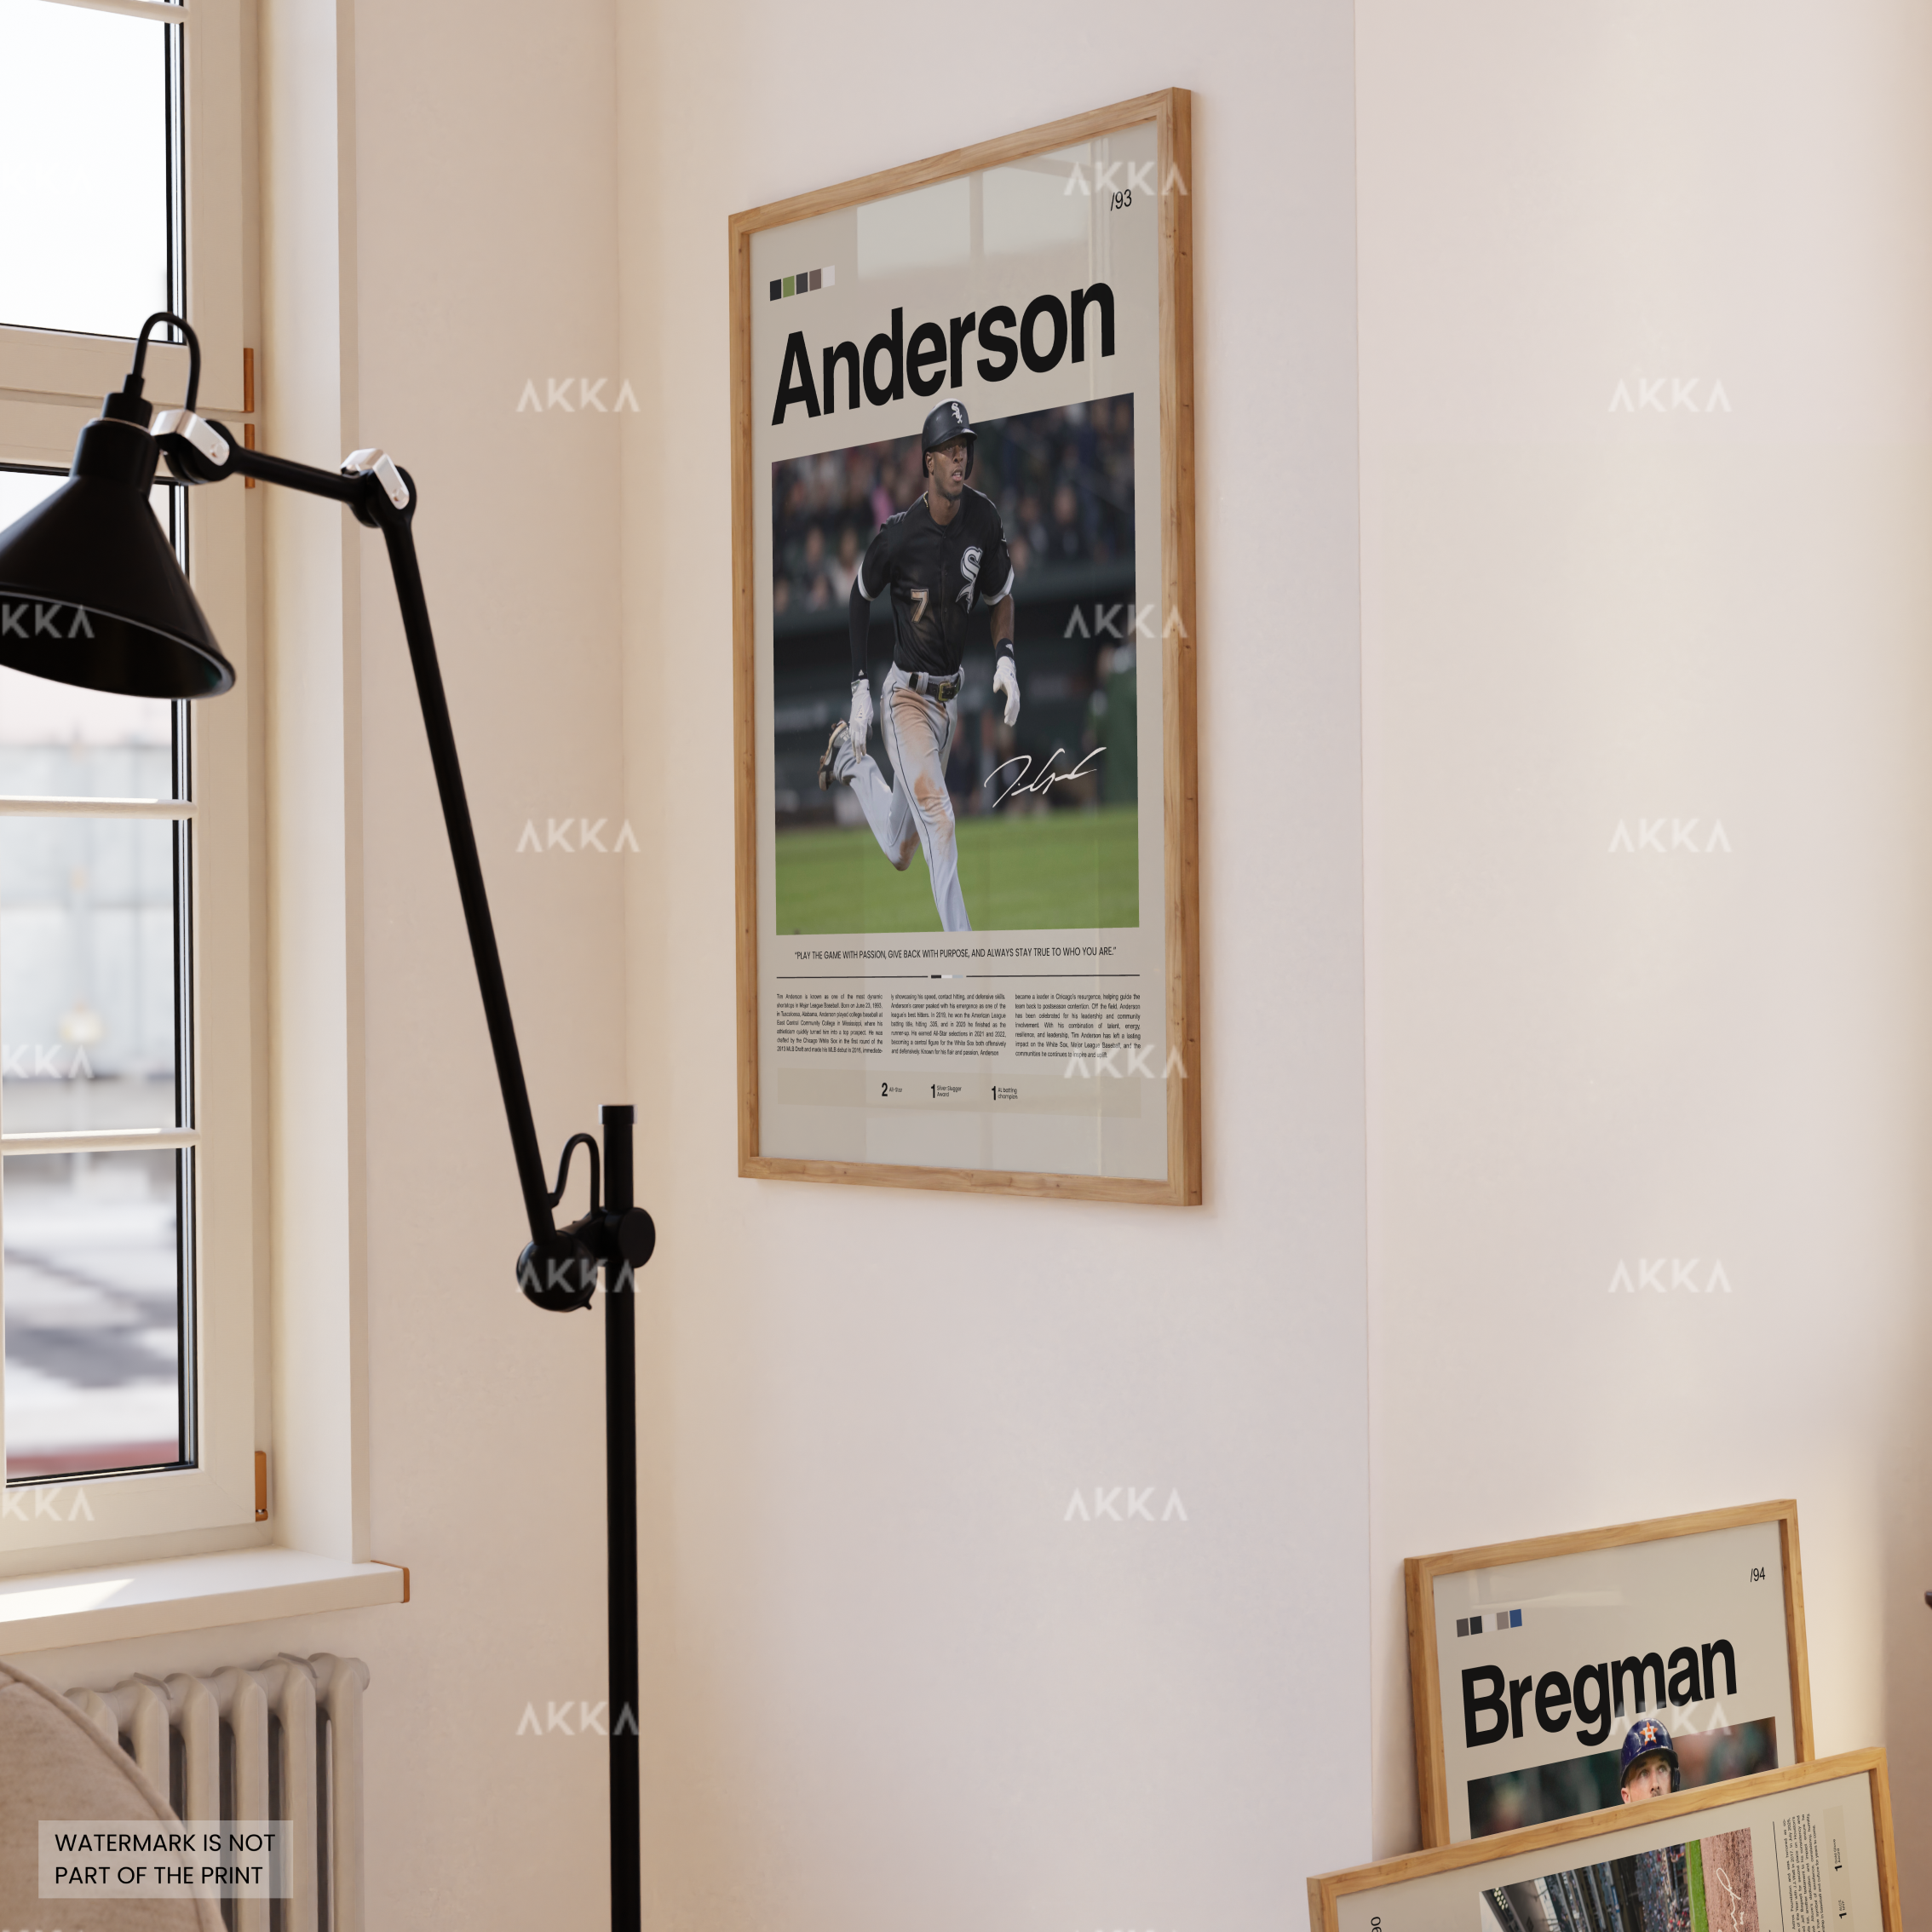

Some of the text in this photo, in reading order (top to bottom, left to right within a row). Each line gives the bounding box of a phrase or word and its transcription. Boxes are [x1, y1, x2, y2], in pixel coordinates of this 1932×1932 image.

[1111, 189, 1131, 211] /93
[772, 283, 1115, 426] Anderson
[911, 589, 929, 623] 7
[813, 951, 822, 959] THE
[824, 951, 841, 959] GAME
[859, 950, 887, 959] PASSION,
[888, 950, 901, 958] GIVE
[903, 949, 920, 958] BACK
[922, 949, 938, 957] WITH
[940, 948, 970, 957] PURPOSE,
[971, 948, 985, 957] AND
[986, 948, 1013, 957] ALWAYS
[1015, 947, 1032, 957] STAY
[1034, 947, 1049, 957] TRUE
[1052, 947, 1061, 957] TO
[1062, 946, 1080, 956] WHO
[1082, 946, 1096, 956] YOU
[882, 1082, 888, 1096] 2
[930, 1084, 935, 1098] 1
[992, 1085, 996, 1101] 1
[1750, 1567, 1765, 1583] /94
[1462, 1638, 1738, 1748] Bregman
